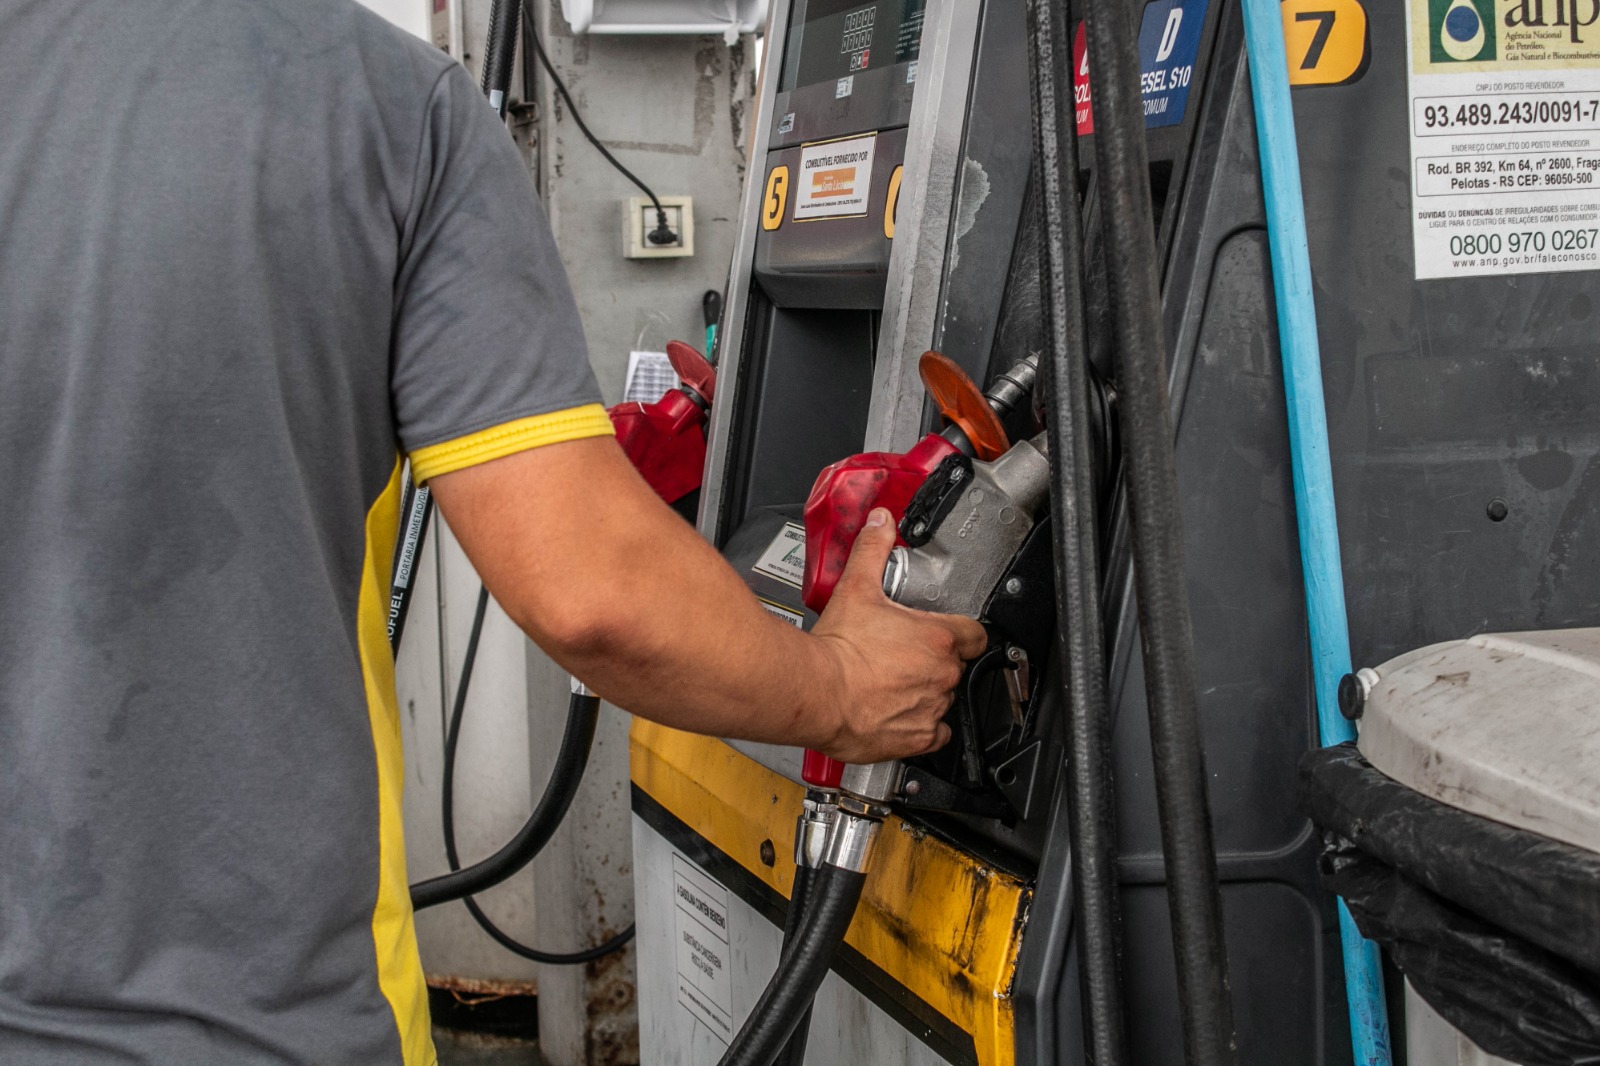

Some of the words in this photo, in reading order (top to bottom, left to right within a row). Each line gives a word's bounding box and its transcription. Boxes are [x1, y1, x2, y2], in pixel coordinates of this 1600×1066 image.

[1155, 7, 1183, 62] D
[1295, 10, 1336, 70] 7
[1505, 31, 1532, 42] Agência
[1533, 30, 1562, 39] Nacional
[1505, 43, 1515, 51] do
[1516, 42, 1545, 50] Petróleo,
[1506, 52, 1519, 61] Gás
[1521, 52, 1546, 60] Natural
[1553, 51, 1600, 60] Biocombustívei
[1140, 69, 1167, 94] ESEL
[1169, 65, 1192, 90] S10
[1476, 83, 1492, 91] CNPJ
[1493, 83, 1502, 91] DO
[1504, 82, 1525, 91] POSTO
[1525, 81, 1565, 90] REVENDEDOR
[1451, 143, 1485, 153] ENDEREÇO
[1486, 141, 1520, 151] COMPLETO
[1521, 141, 1530, 150] DO
[1531, 140, 1550, 149] POSTO
[1552, 139, 1590, 148] REVENDEDOR
[805, 155, 833, 169] COMBUSTÍVEL
[833, 153, 858, 165] FORNECIDO
[859, 151, 868, 161] POR
[1428, 163, 1452, 175] Rod.
[1456, 161, 1471, 173] BR
[1474, 161, 1496, 174] 392,
[1498, 160, 1515, 172] Km
[1518, 159, 1533, 173] 64,
[1536, 158, 1546, 170] nº
[1549, 157, 1574, 170] 2600,
[1451, 177, 1490, 190] Pelotas
[1500, 175, 1514, 187] RS
[1517, 174, 1542, 186] CEP:
[1544, 172, 1592, 185] 96050-500
[769, 176, 783, 219] 5
[1418, 209, 1446, 219] DÚVIDAS
[1448, 210, 1457, 218] OU
[1458, 208, 1493, 218] DENÚNCIAS
[1505, 205, 1558, 215] IRREGULARIDADES
[1560, 204, 1579, 213] SOBRE
[1580, 203, 1600, 211] COMBU
[1466, 219, 1471, 227] O
[1472, 218, 1497, 226] CENTRO
[1498, 217, 1506, 225] DE
[1508, 215, 1539, 225] RELAÇÕES
[1540, 215, 1553, 223] COM
[1554, 214, 1559, 222] O
[1560, 213, 1598, 222] CONSUMIDOR
[1450, 233, 1502, 256] 0800
[1508, 231, 1546, 253] 970
[1552, 229, 1599, 251] 0267
[1453, 253, 1597, 267] www.anp.gov.br/faleconosco
[400, 541, 416, 581] PORTARIA
